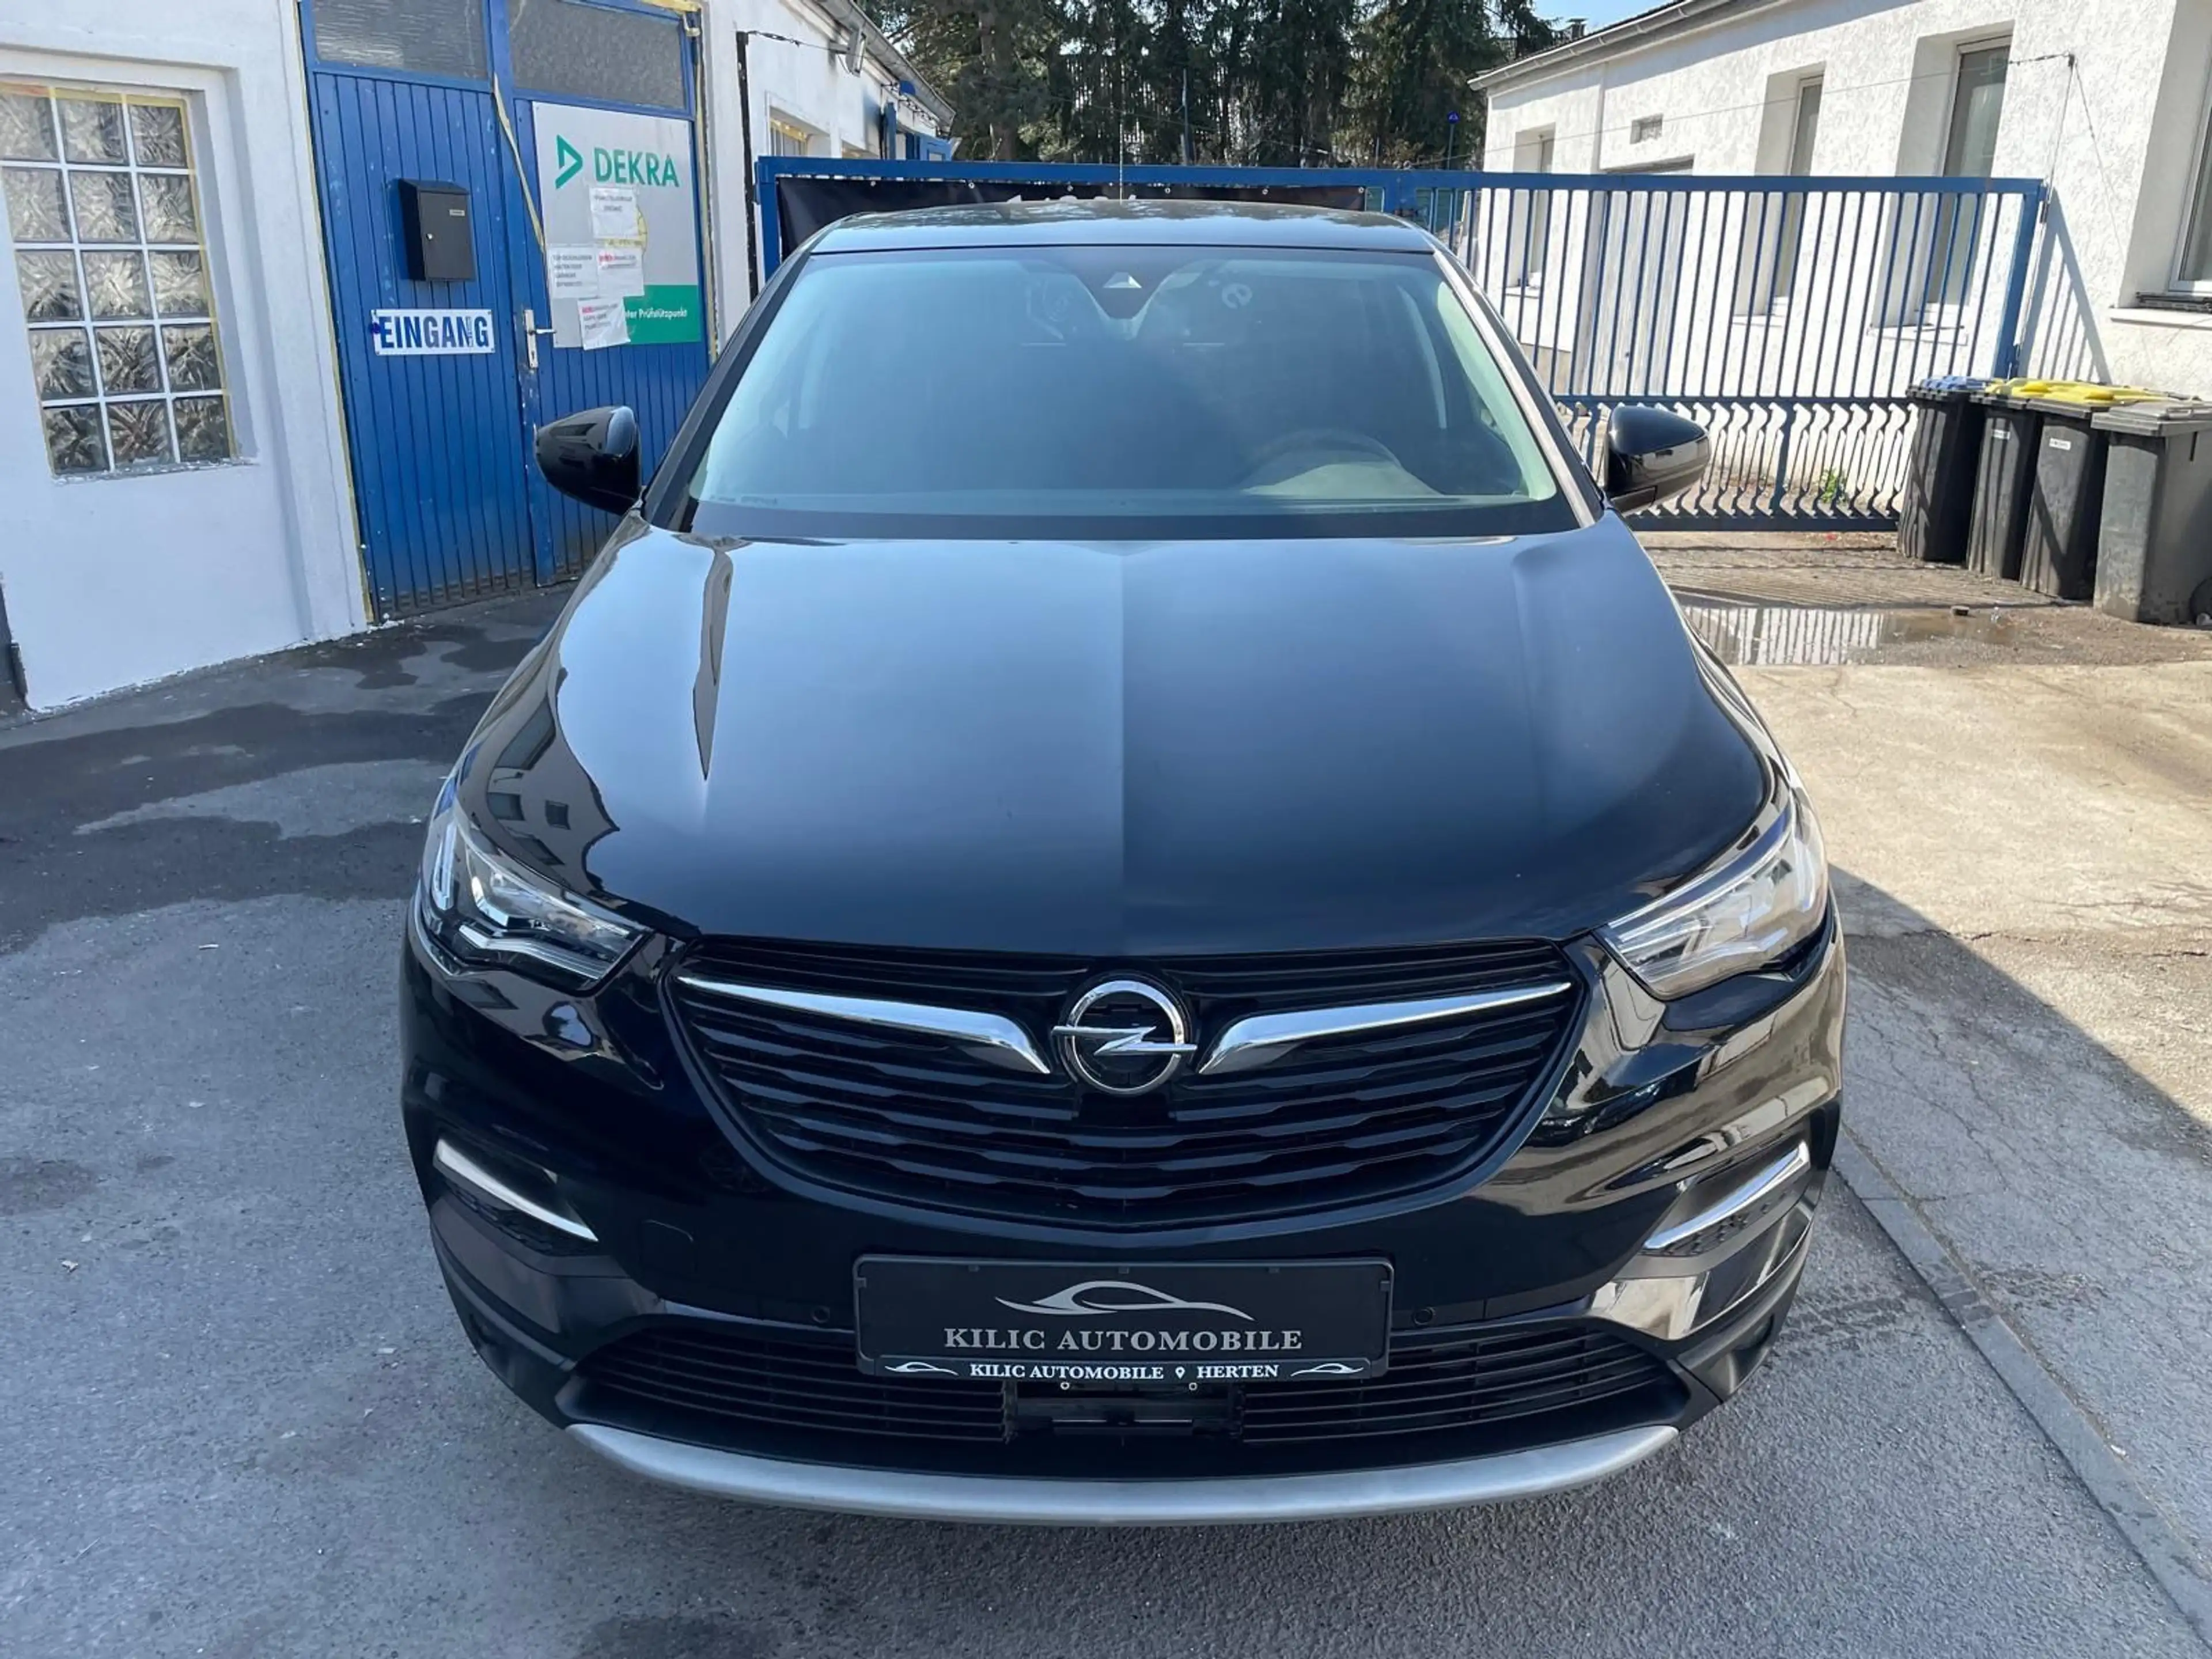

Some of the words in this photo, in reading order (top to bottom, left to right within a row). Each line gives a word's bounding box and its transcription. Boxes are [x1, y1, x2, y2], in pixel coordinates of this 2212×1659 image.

[594, 147, 680, 188] DEKRA
[378, 316, 490, 348] EINGANG
[944, 1328, 1046, 1350] KILIC
[1056, 1330, 1302, 1351] AUTOMOBILE
[969, 1363, 1026, 1378] KILIC
[1029, 1365, 1165, 1380] AUTOMOBILE
[1196, 1364, 1279, 1379] HERTEN
